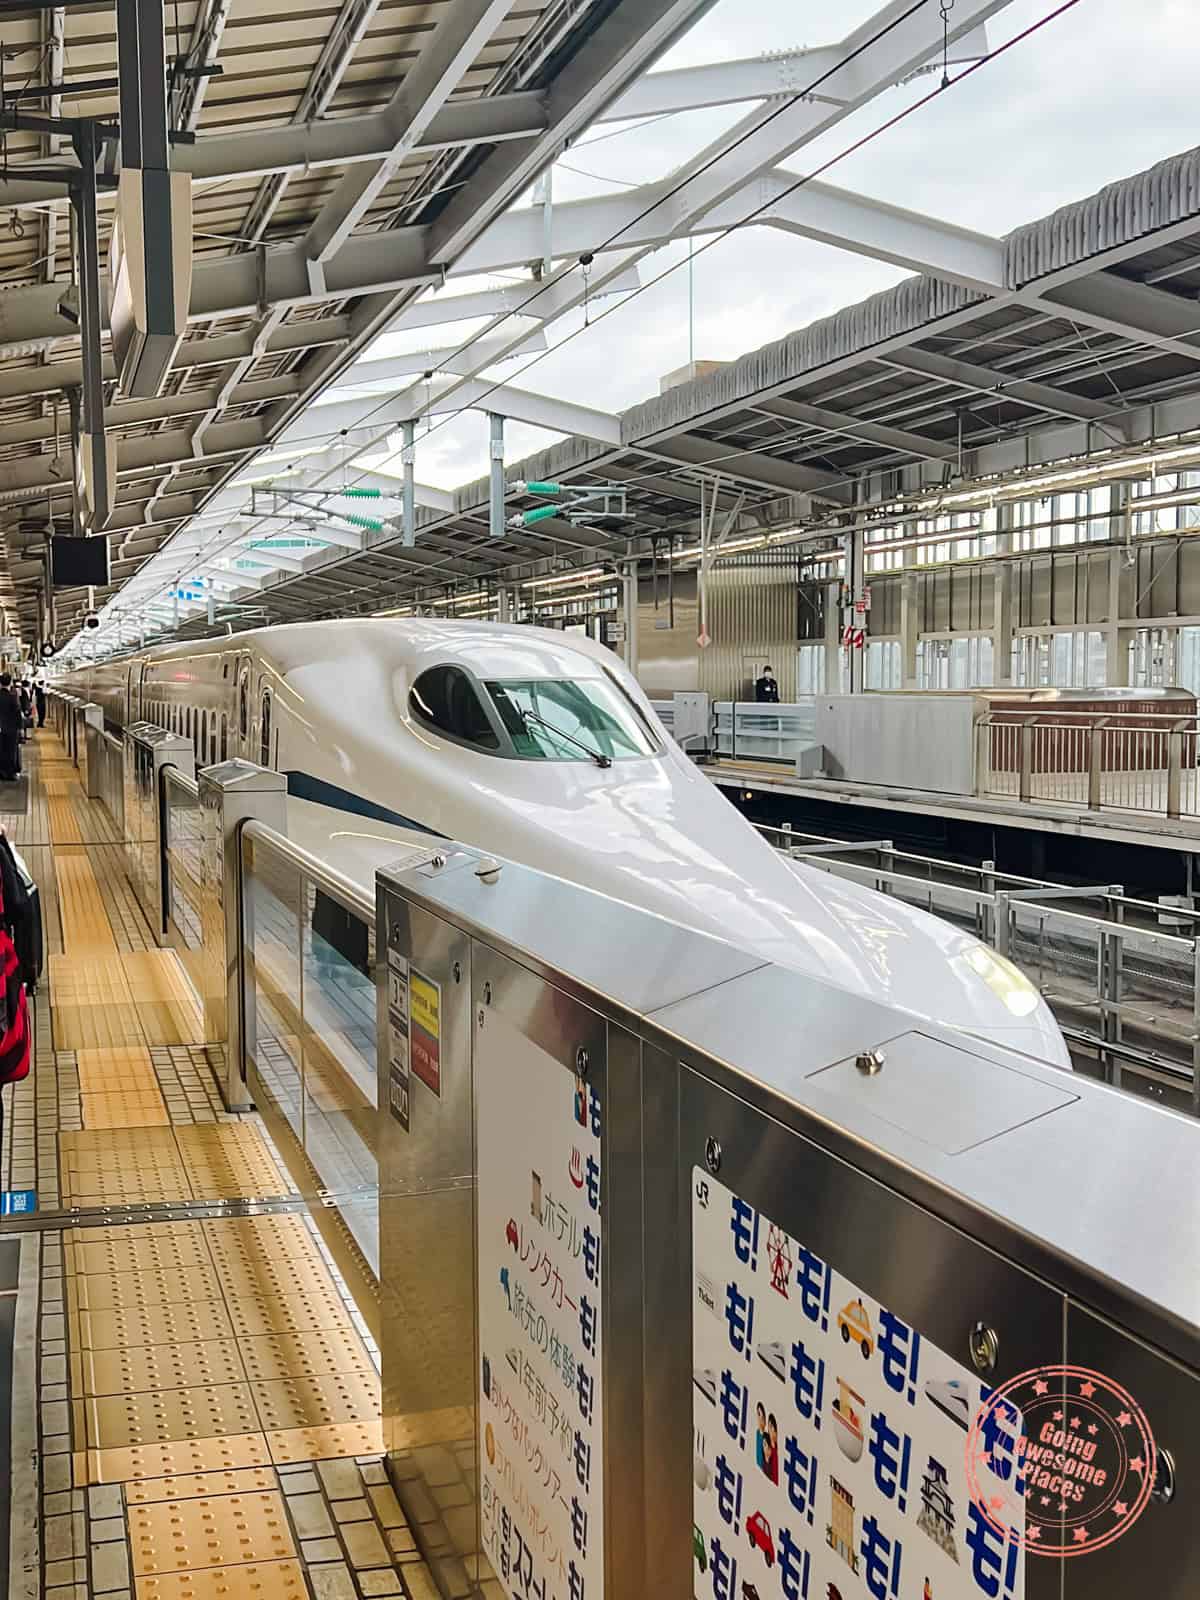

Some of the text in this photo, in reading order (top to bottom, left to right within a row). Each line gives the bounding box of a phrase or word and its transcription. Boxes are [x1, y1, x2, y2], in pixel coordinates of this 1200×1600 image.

[544, 1192, 600, 1288] ホテル も!
[520, 1223, 597, 1358] レンタカー も!
[731, 1196, 760, 1272] も!
[797, 1247, 832, 1333] も!
[877, 1308, 920, 1406] も!
[576, 1362, 594, 1426] も!
[726, 1282, 754, 1363] も!
[790, 1340, 825, 1431] も!
[869, 1412, 912, 1513] も!
[574, 1429, 591, 1494] も!
[714, 1454, 742, 1536] も!
[720, 1369, 817, 1527] も! も!
[570, 1496, 588, 1560] も!
